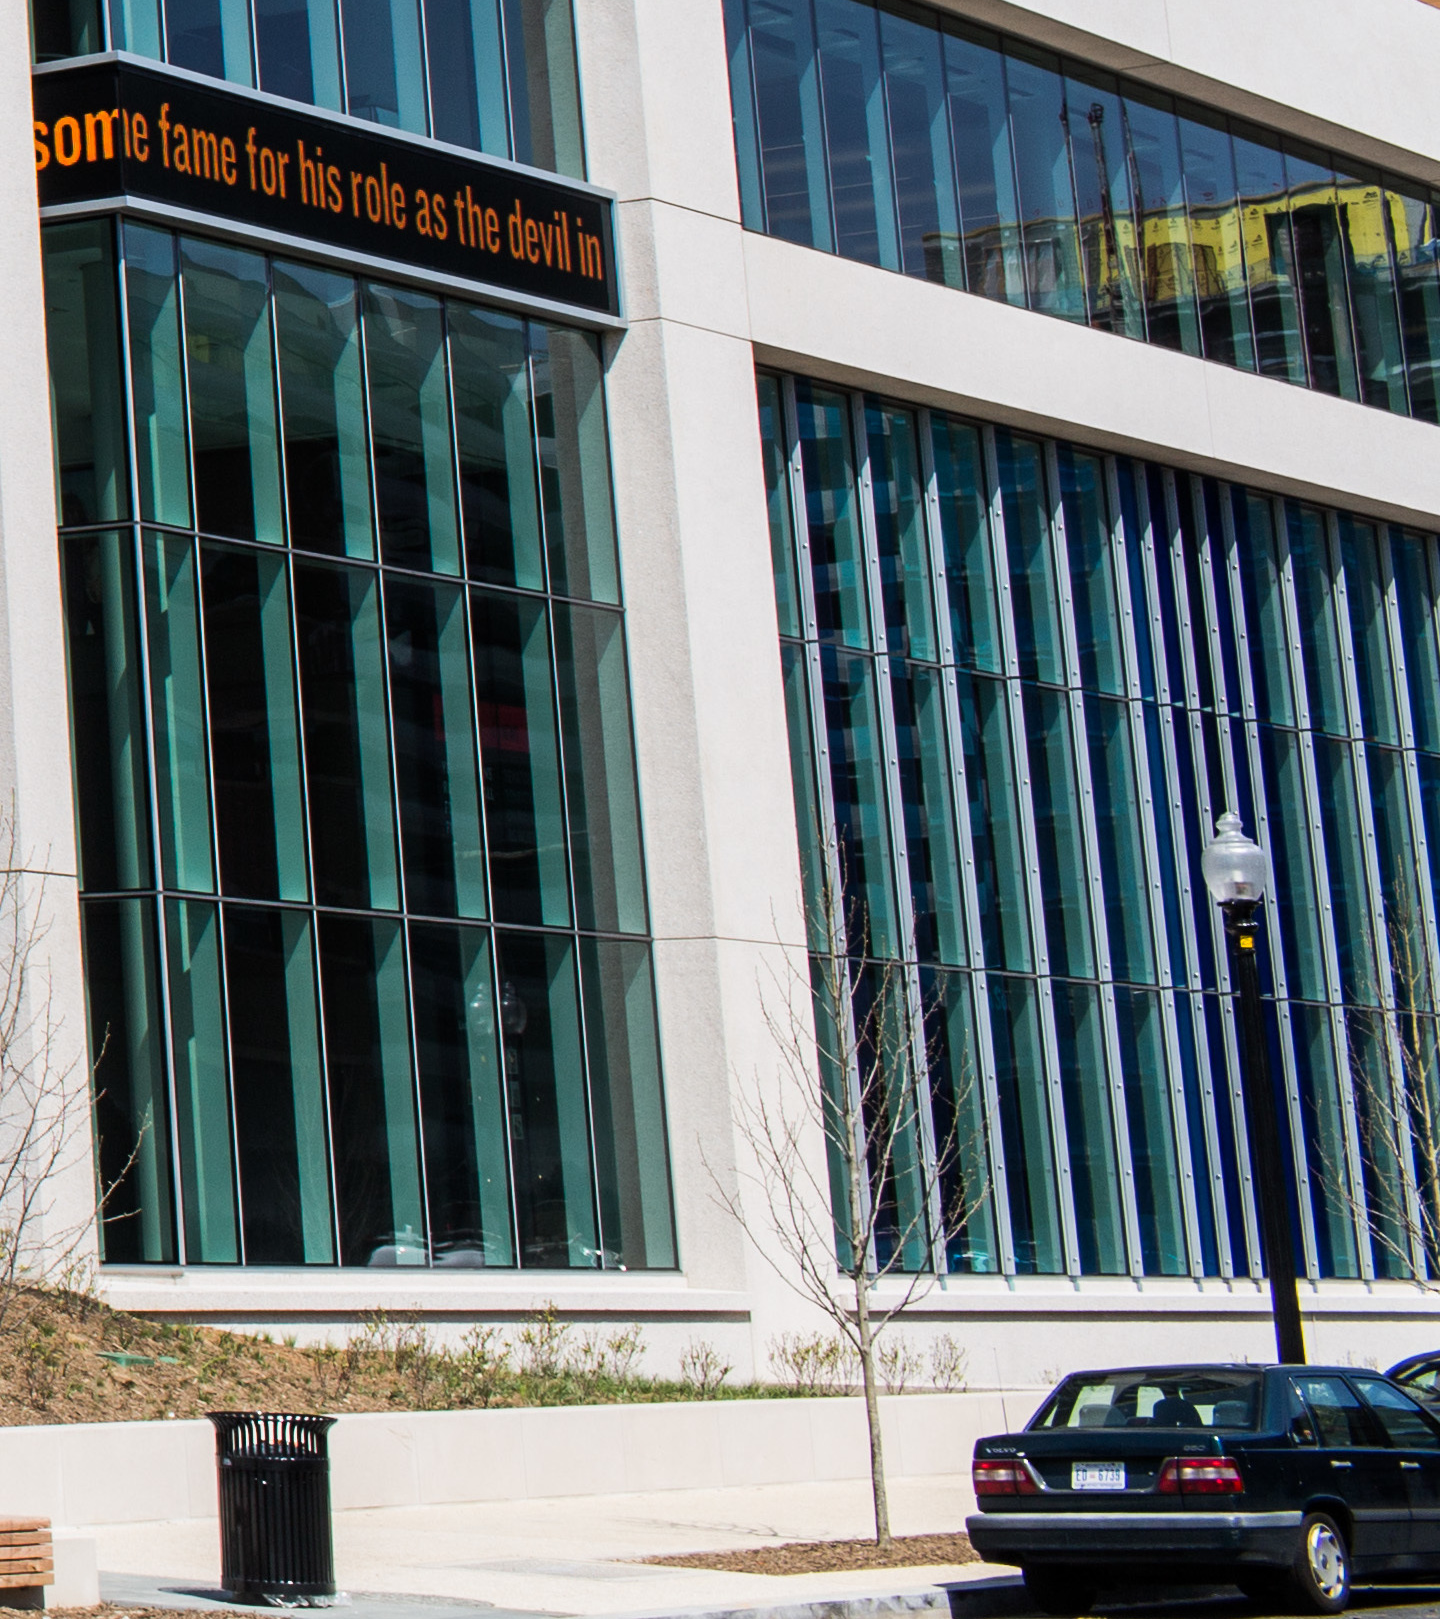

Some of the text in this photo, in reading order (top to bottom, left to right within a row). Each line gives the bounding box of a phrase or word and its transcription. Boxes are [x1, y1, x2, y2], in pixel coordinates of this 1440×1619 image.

[33, 102, 603, 281] some fame for his role as the devil in
